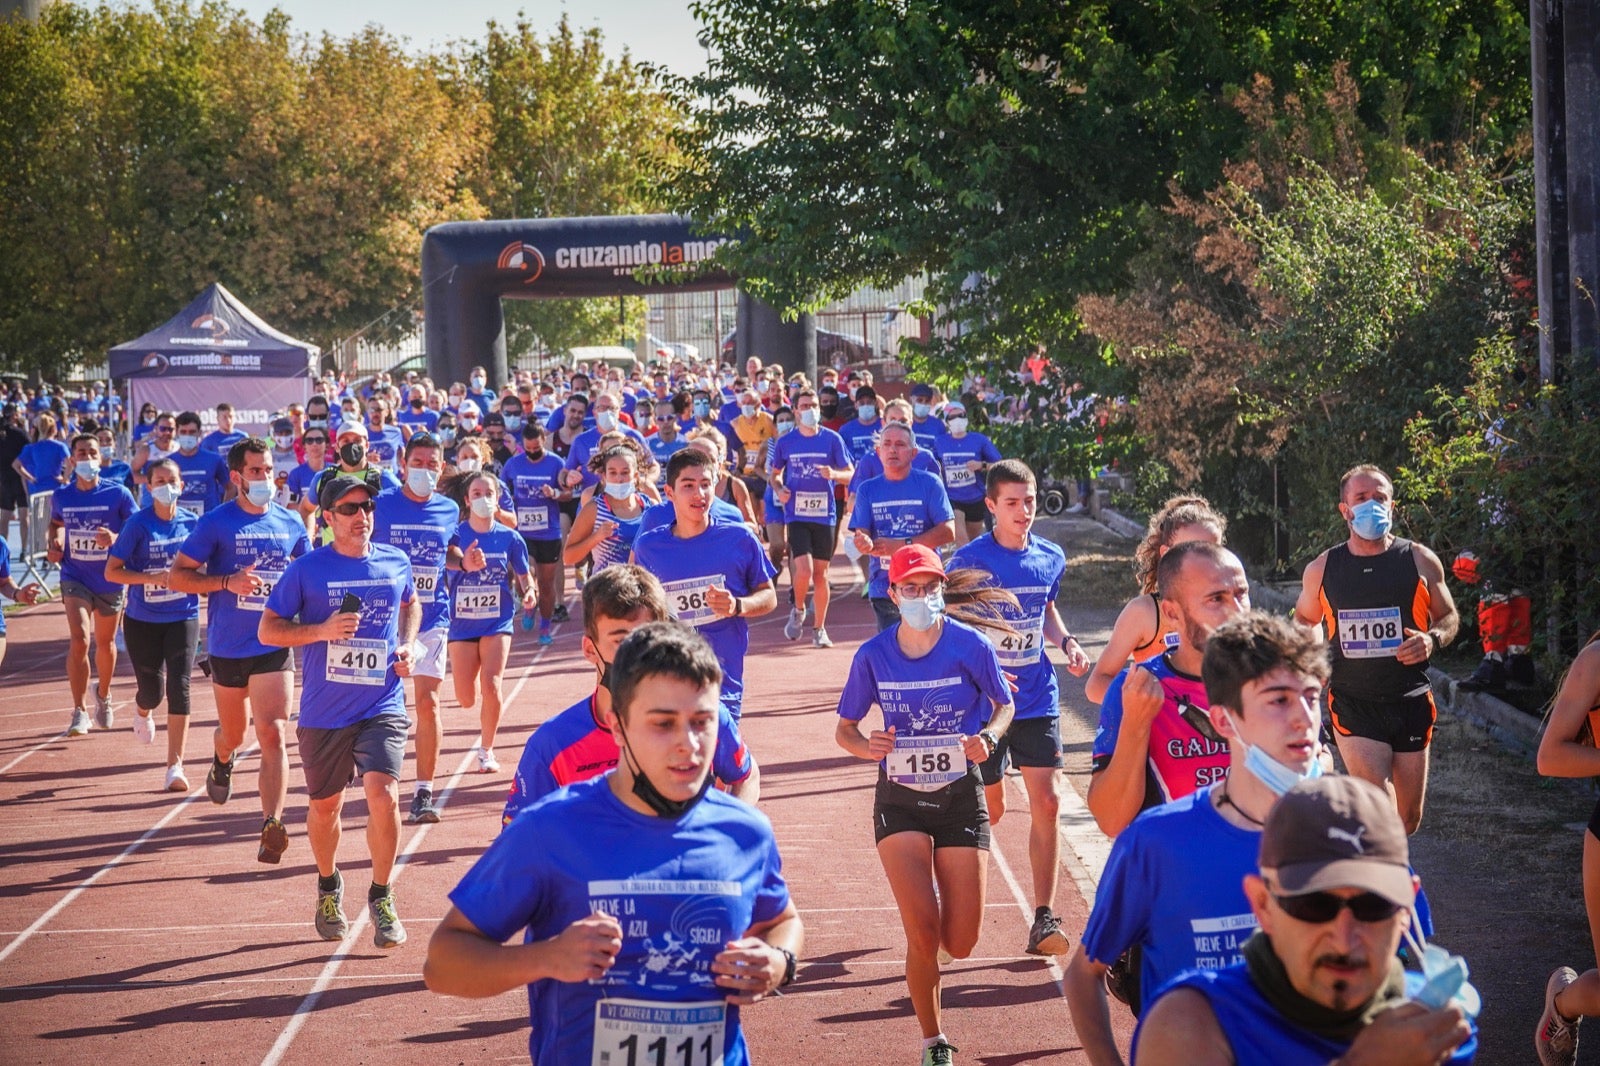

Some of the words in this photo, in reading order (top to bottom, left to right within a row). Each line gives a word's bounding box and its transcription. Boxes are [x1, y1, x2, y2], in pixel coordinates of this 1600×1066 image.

[556, 237, 741, 268] cruzandolame
[169, 352, 261, 367] cruzandolameta
[952, 472, 969, 480] 306
[804, 500, 821, 508] 157
[525, 514, 543, 522] 533
[75, 539, 105, 550] 117
[463, 595, 497, 607] 1122
[1349, 622, 1397, 640] 1108
[1001, 633, 1033, 650] 412
[341, 651, 377, 669] 410
[906, 752, 951, 773] 158
[589, 899, 621, 916] VUELVE
[624, 898, 636, 914] LA
[627, 919, 648, 937] AZUL
[1193, 935, 1222, 953] VUELVE
[1224, 933, 1238, 950] LA
[618, 1033, 713, 1066] 1111
